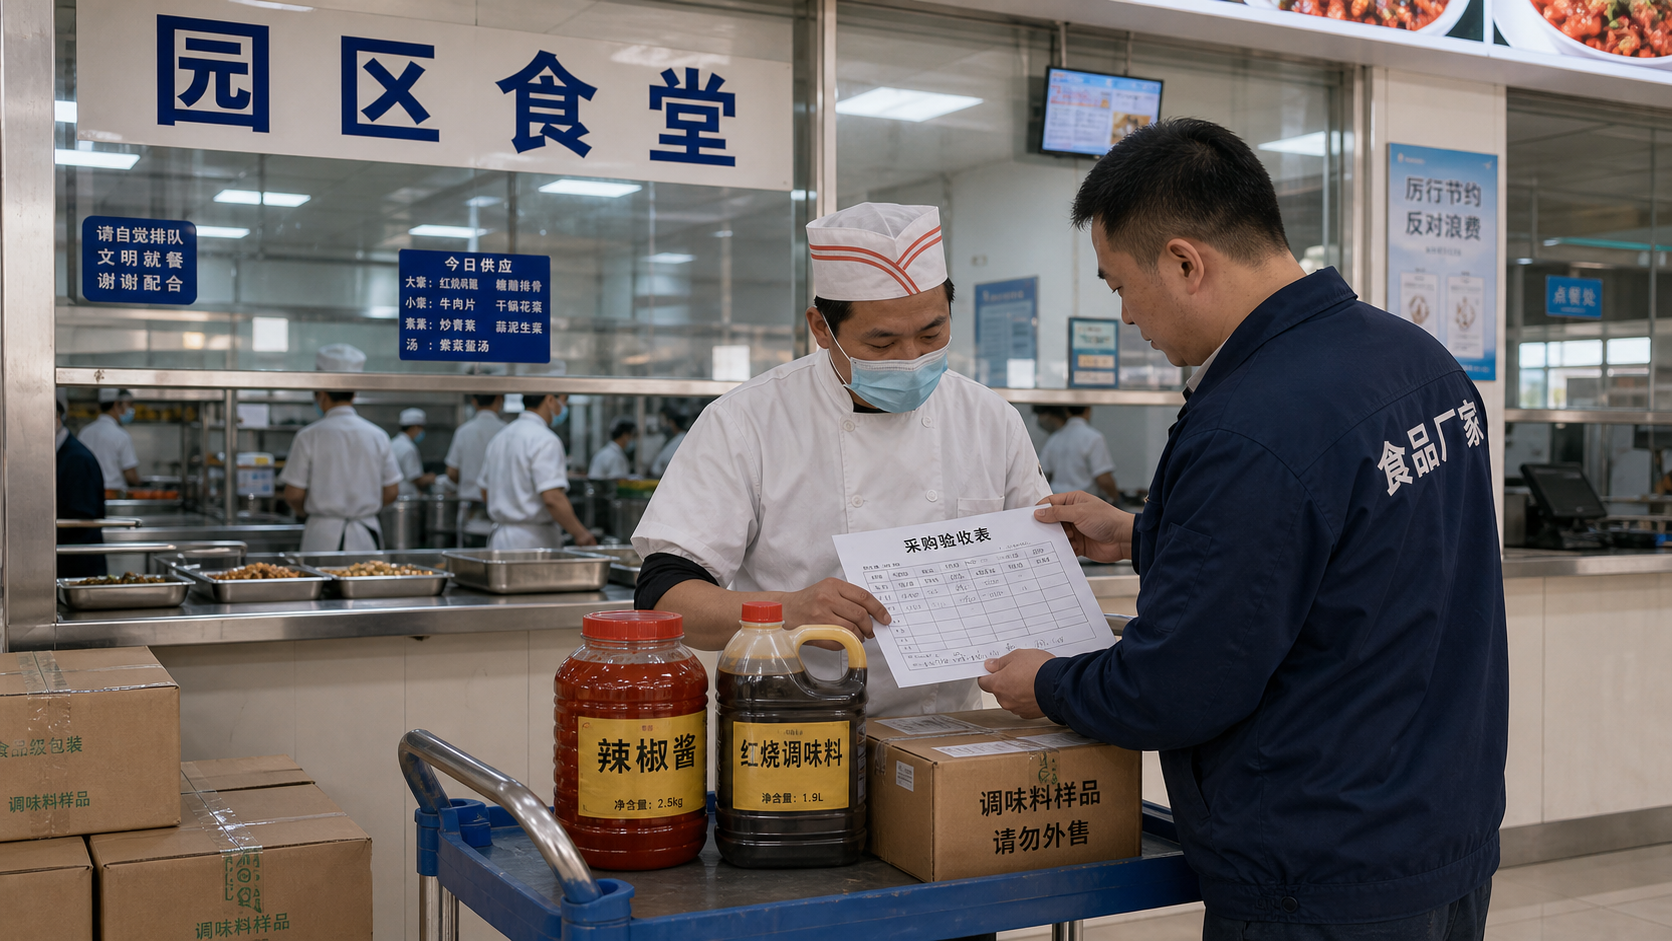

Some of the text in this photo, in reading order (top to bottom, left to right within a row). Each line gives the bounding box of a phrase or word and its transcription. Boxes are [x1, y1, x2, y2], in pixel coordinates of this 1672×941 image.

[157, 14, 736, 167] 园区食堂
[1405, 177, 1482, 208] 厉行节约
[96, 225, 184, 245] 请自觉排队
[1405, 211, 1482, 241] 反对浪费
[97, 248, 184, 269] 文明就餐
[444, 256, 513, 273] 今日供应
[97, 272, 184, 293] 谢谢配合
[1377, 399, 1484, 497] 食品厂家
[903, 527, 992, 554] 采购验收表
[597, 733, 697, 774] 辣椒酱
[740, 738, 843, 768] 红烧调味料
[9, 790, 90, 813] 调味料样品
[979, 779, 1101, 817] 调味料样品
[992, 819, 1090, 856] 请勿外售
[195, 912, 290, 940] 调味料样品
